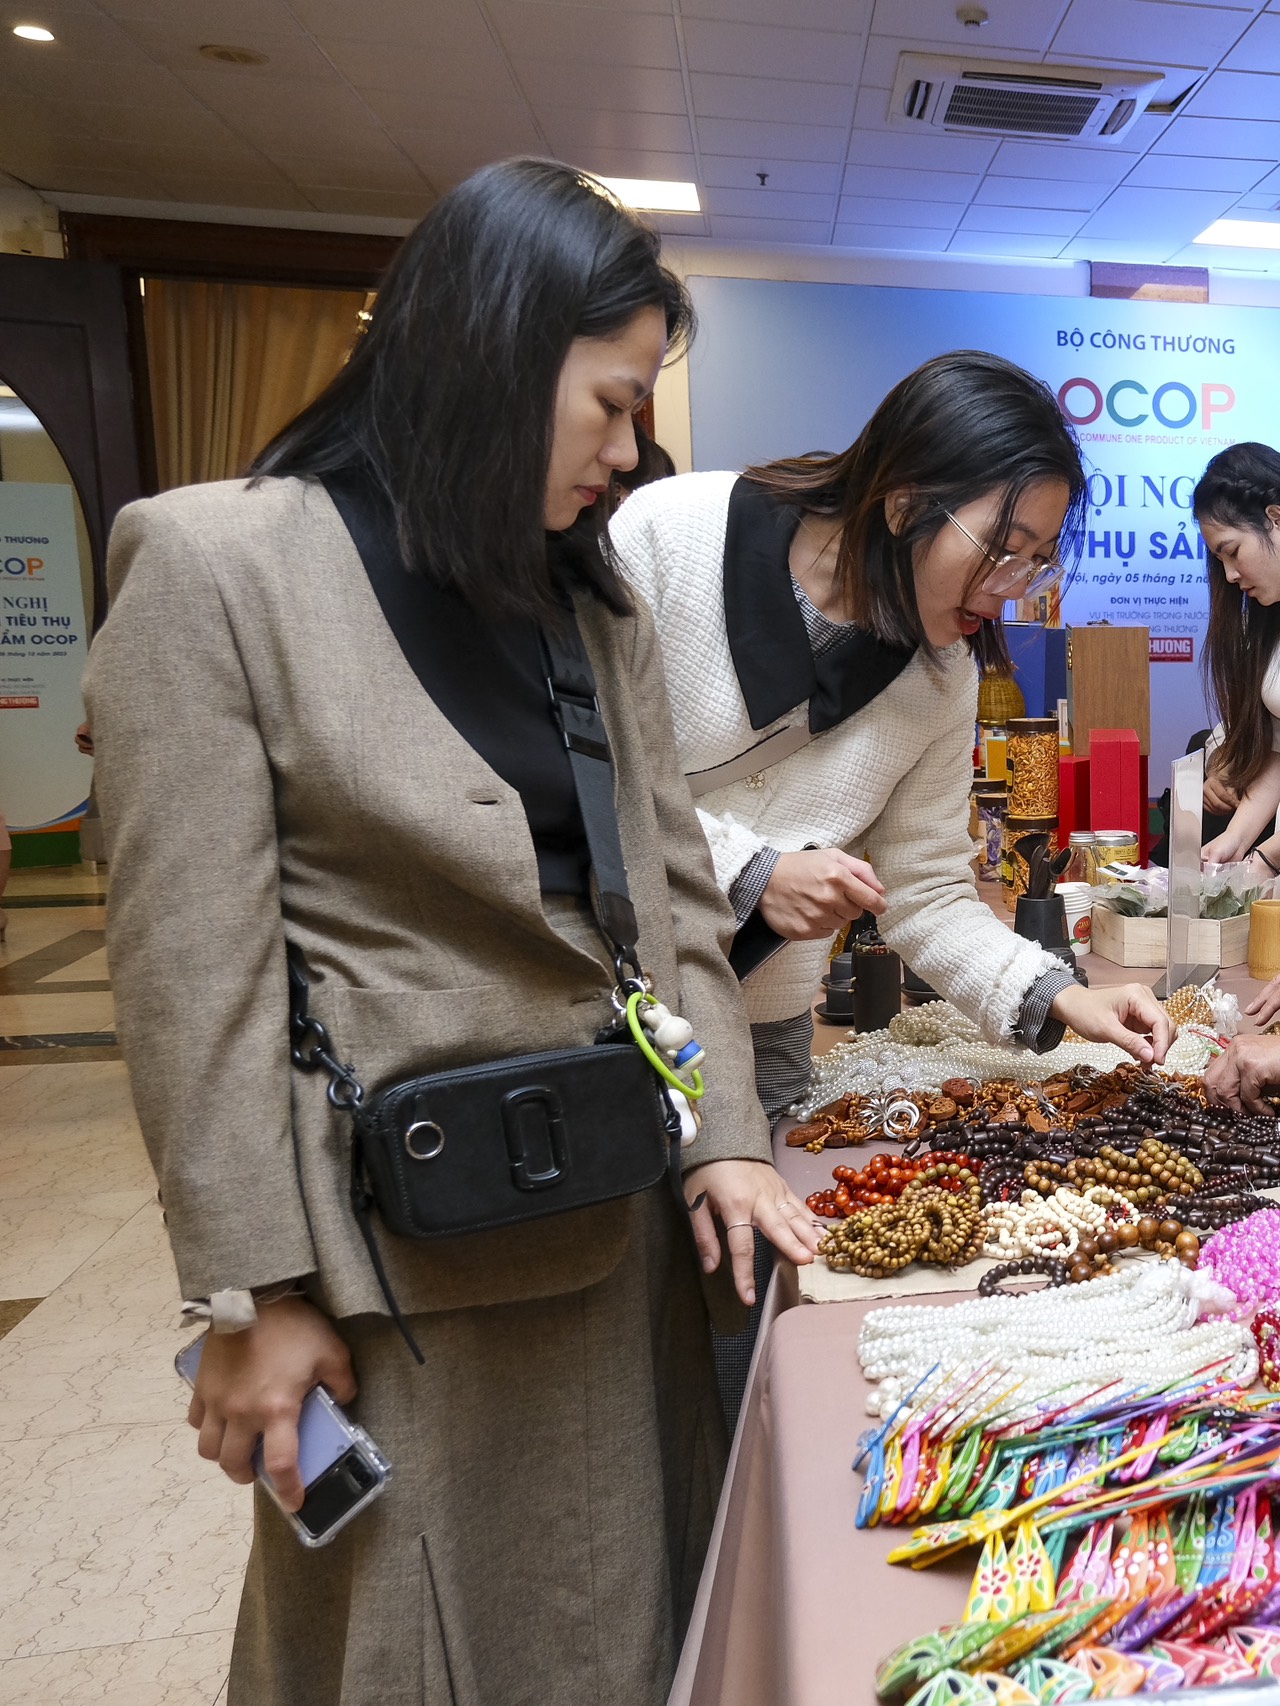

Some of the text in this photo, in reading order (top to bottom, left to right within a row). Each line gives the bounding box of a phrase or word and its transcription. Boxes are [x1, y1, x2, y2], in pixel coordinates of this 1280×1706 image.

[1056, 327, 1236, 354] BỘ CÔNG THƯƠNG
[1057, 377, 1236, 430] OCOP
[1080, 433, 1236, 446] COMMUNE ONE PRODUCT OF VIETNAM
[1083, 468, 1198, 517] ỘI NG
[0, 557, 44, 576] OP
[1092, 572, 1122, 586] ngày
[1125, 573, 1140, 583] 05
[1142, 573, 1176, 586] tháng
[1180, 574, 1193, 584] 12
[3, 596, 48, 613] NGHỊ
[1110, 595, 1189, 607] ĐƠN VỊ THỰC HIỆN
[5, 613, 71, 630] TIÊU THỤ
[1153, 611, 1182, 620] TRONG
[31, 634, 78, 645] OCOP
